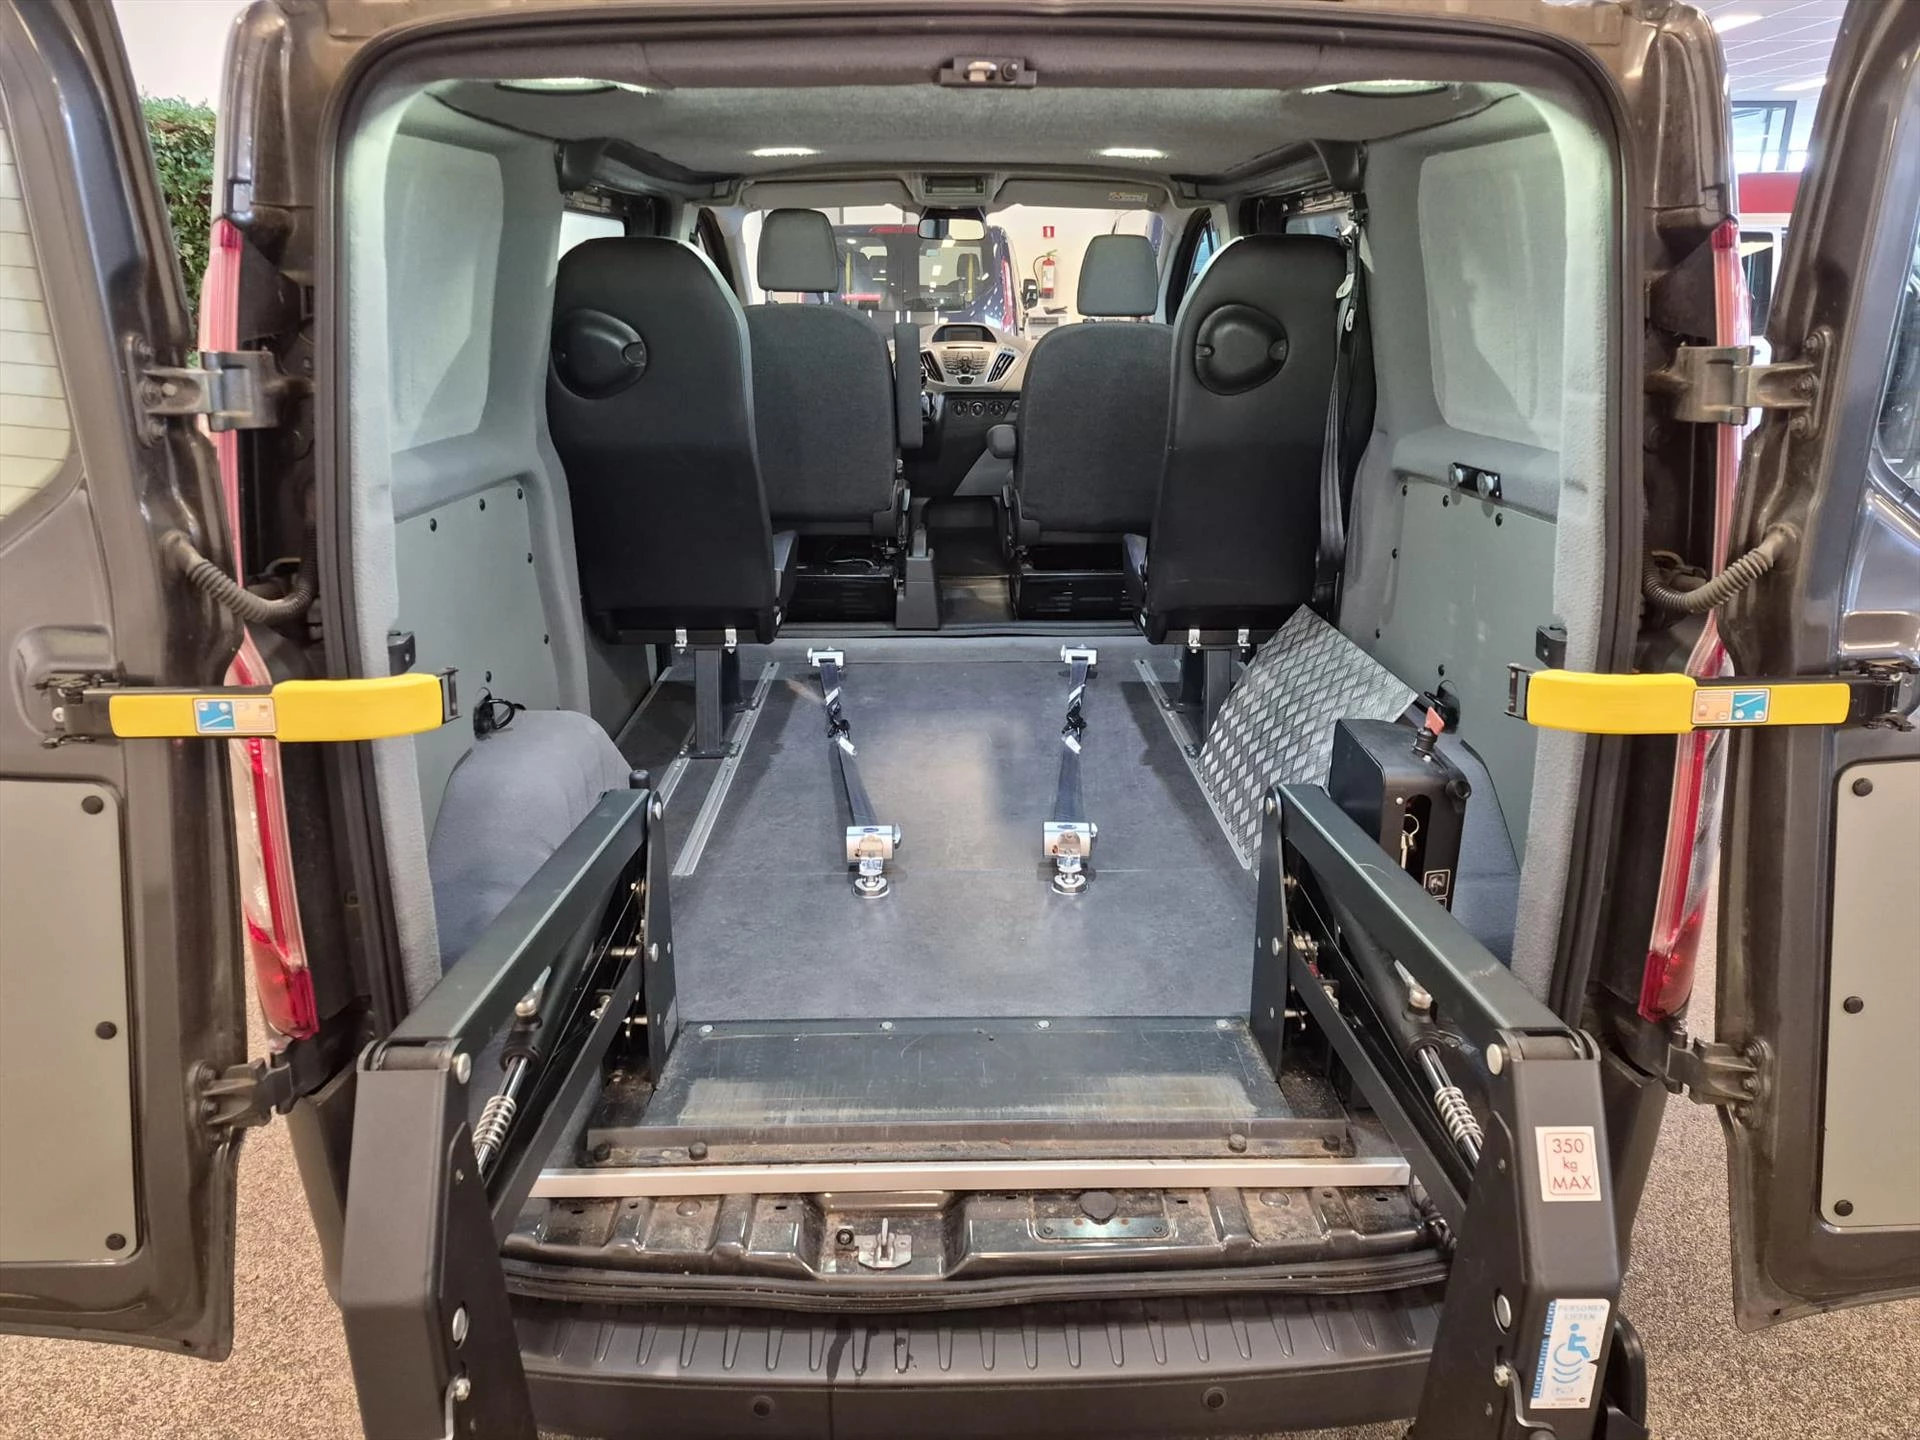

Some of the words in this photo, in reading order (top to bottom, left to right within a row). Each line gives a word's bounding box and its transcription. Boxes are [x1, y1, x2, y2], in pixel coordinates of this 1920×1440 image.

[1552, 1138, 1584, 1153] 350
[1562, 1156, 1578, 1172] kg
[1553, 1175, 1592, 1190] MAX
[1558, 1304, 1607, 1312] PERSONEN
